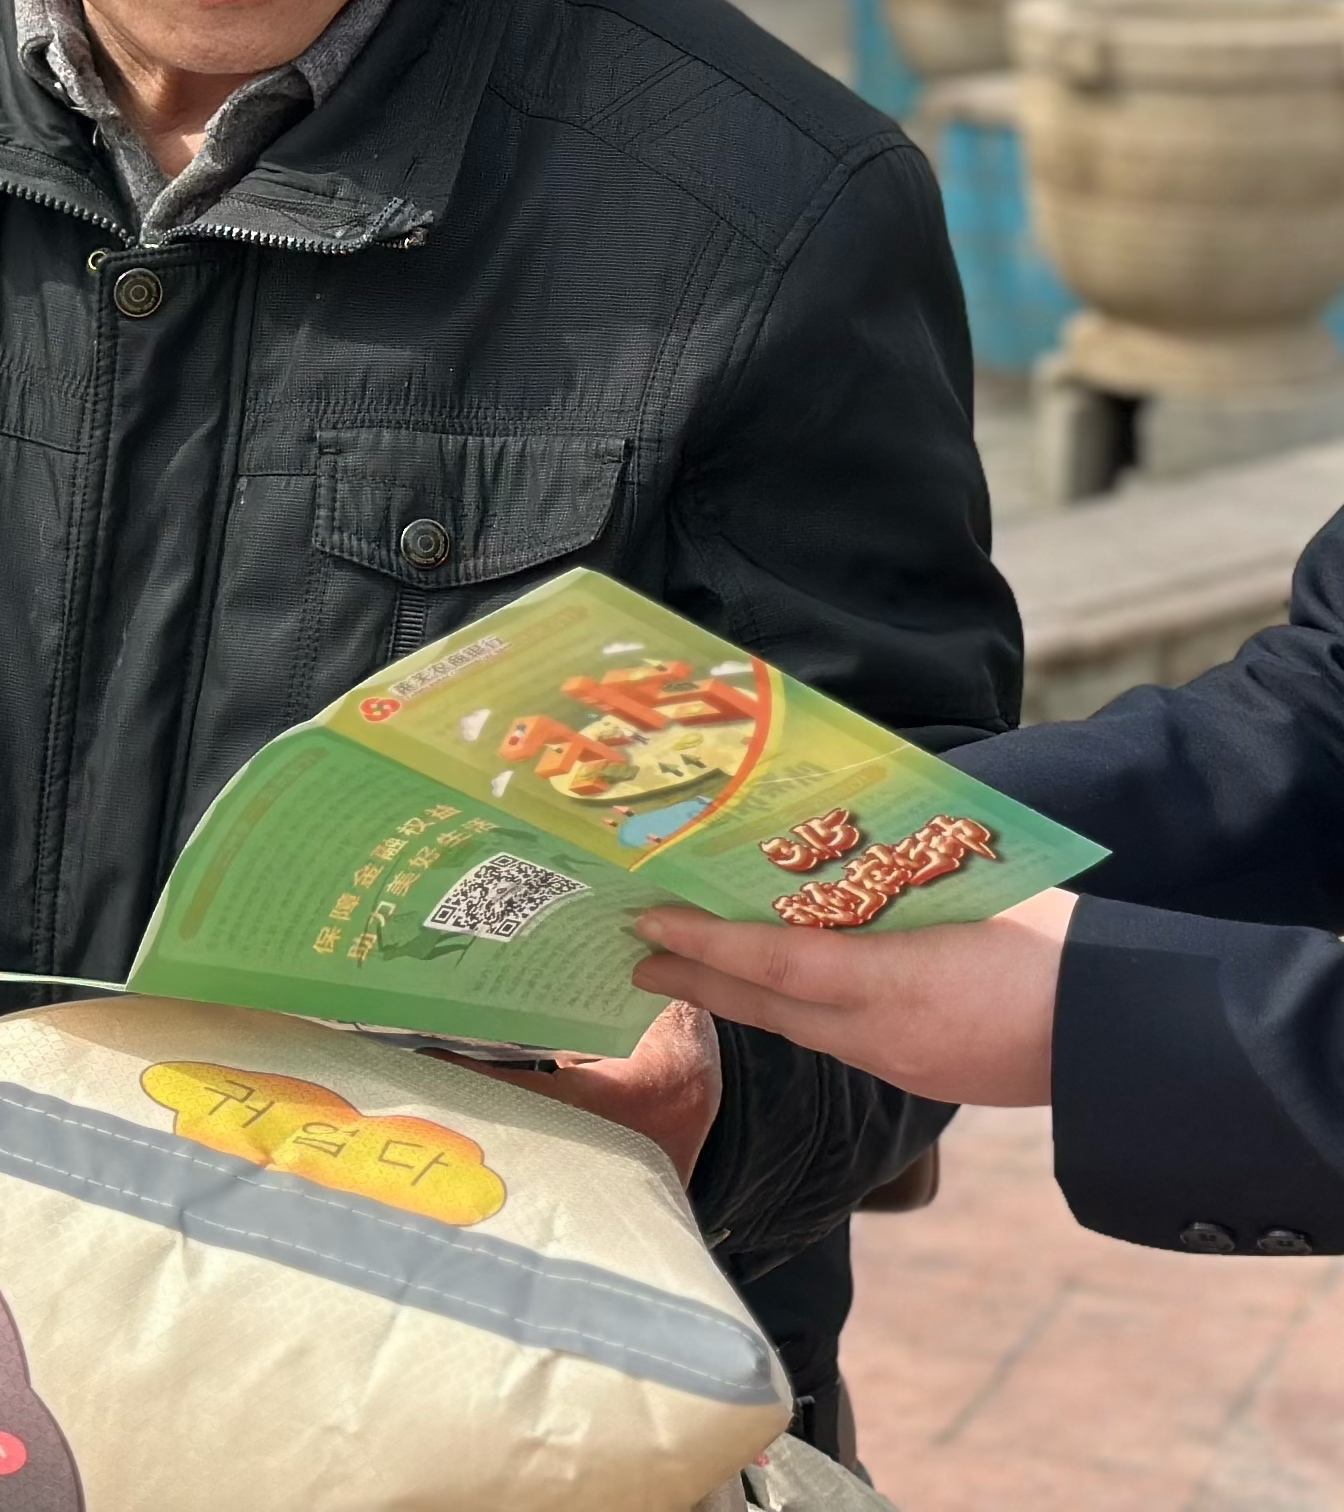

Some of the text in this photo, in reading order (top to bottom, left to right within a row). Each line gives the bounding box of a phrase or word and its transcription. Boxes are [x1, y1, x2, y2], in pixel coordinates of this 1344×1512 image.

[312, 803, 463, 954] 保障金融权益
[346, 816, 501, 961] 助力美好生活
[757, 806, 860, 873] 315
